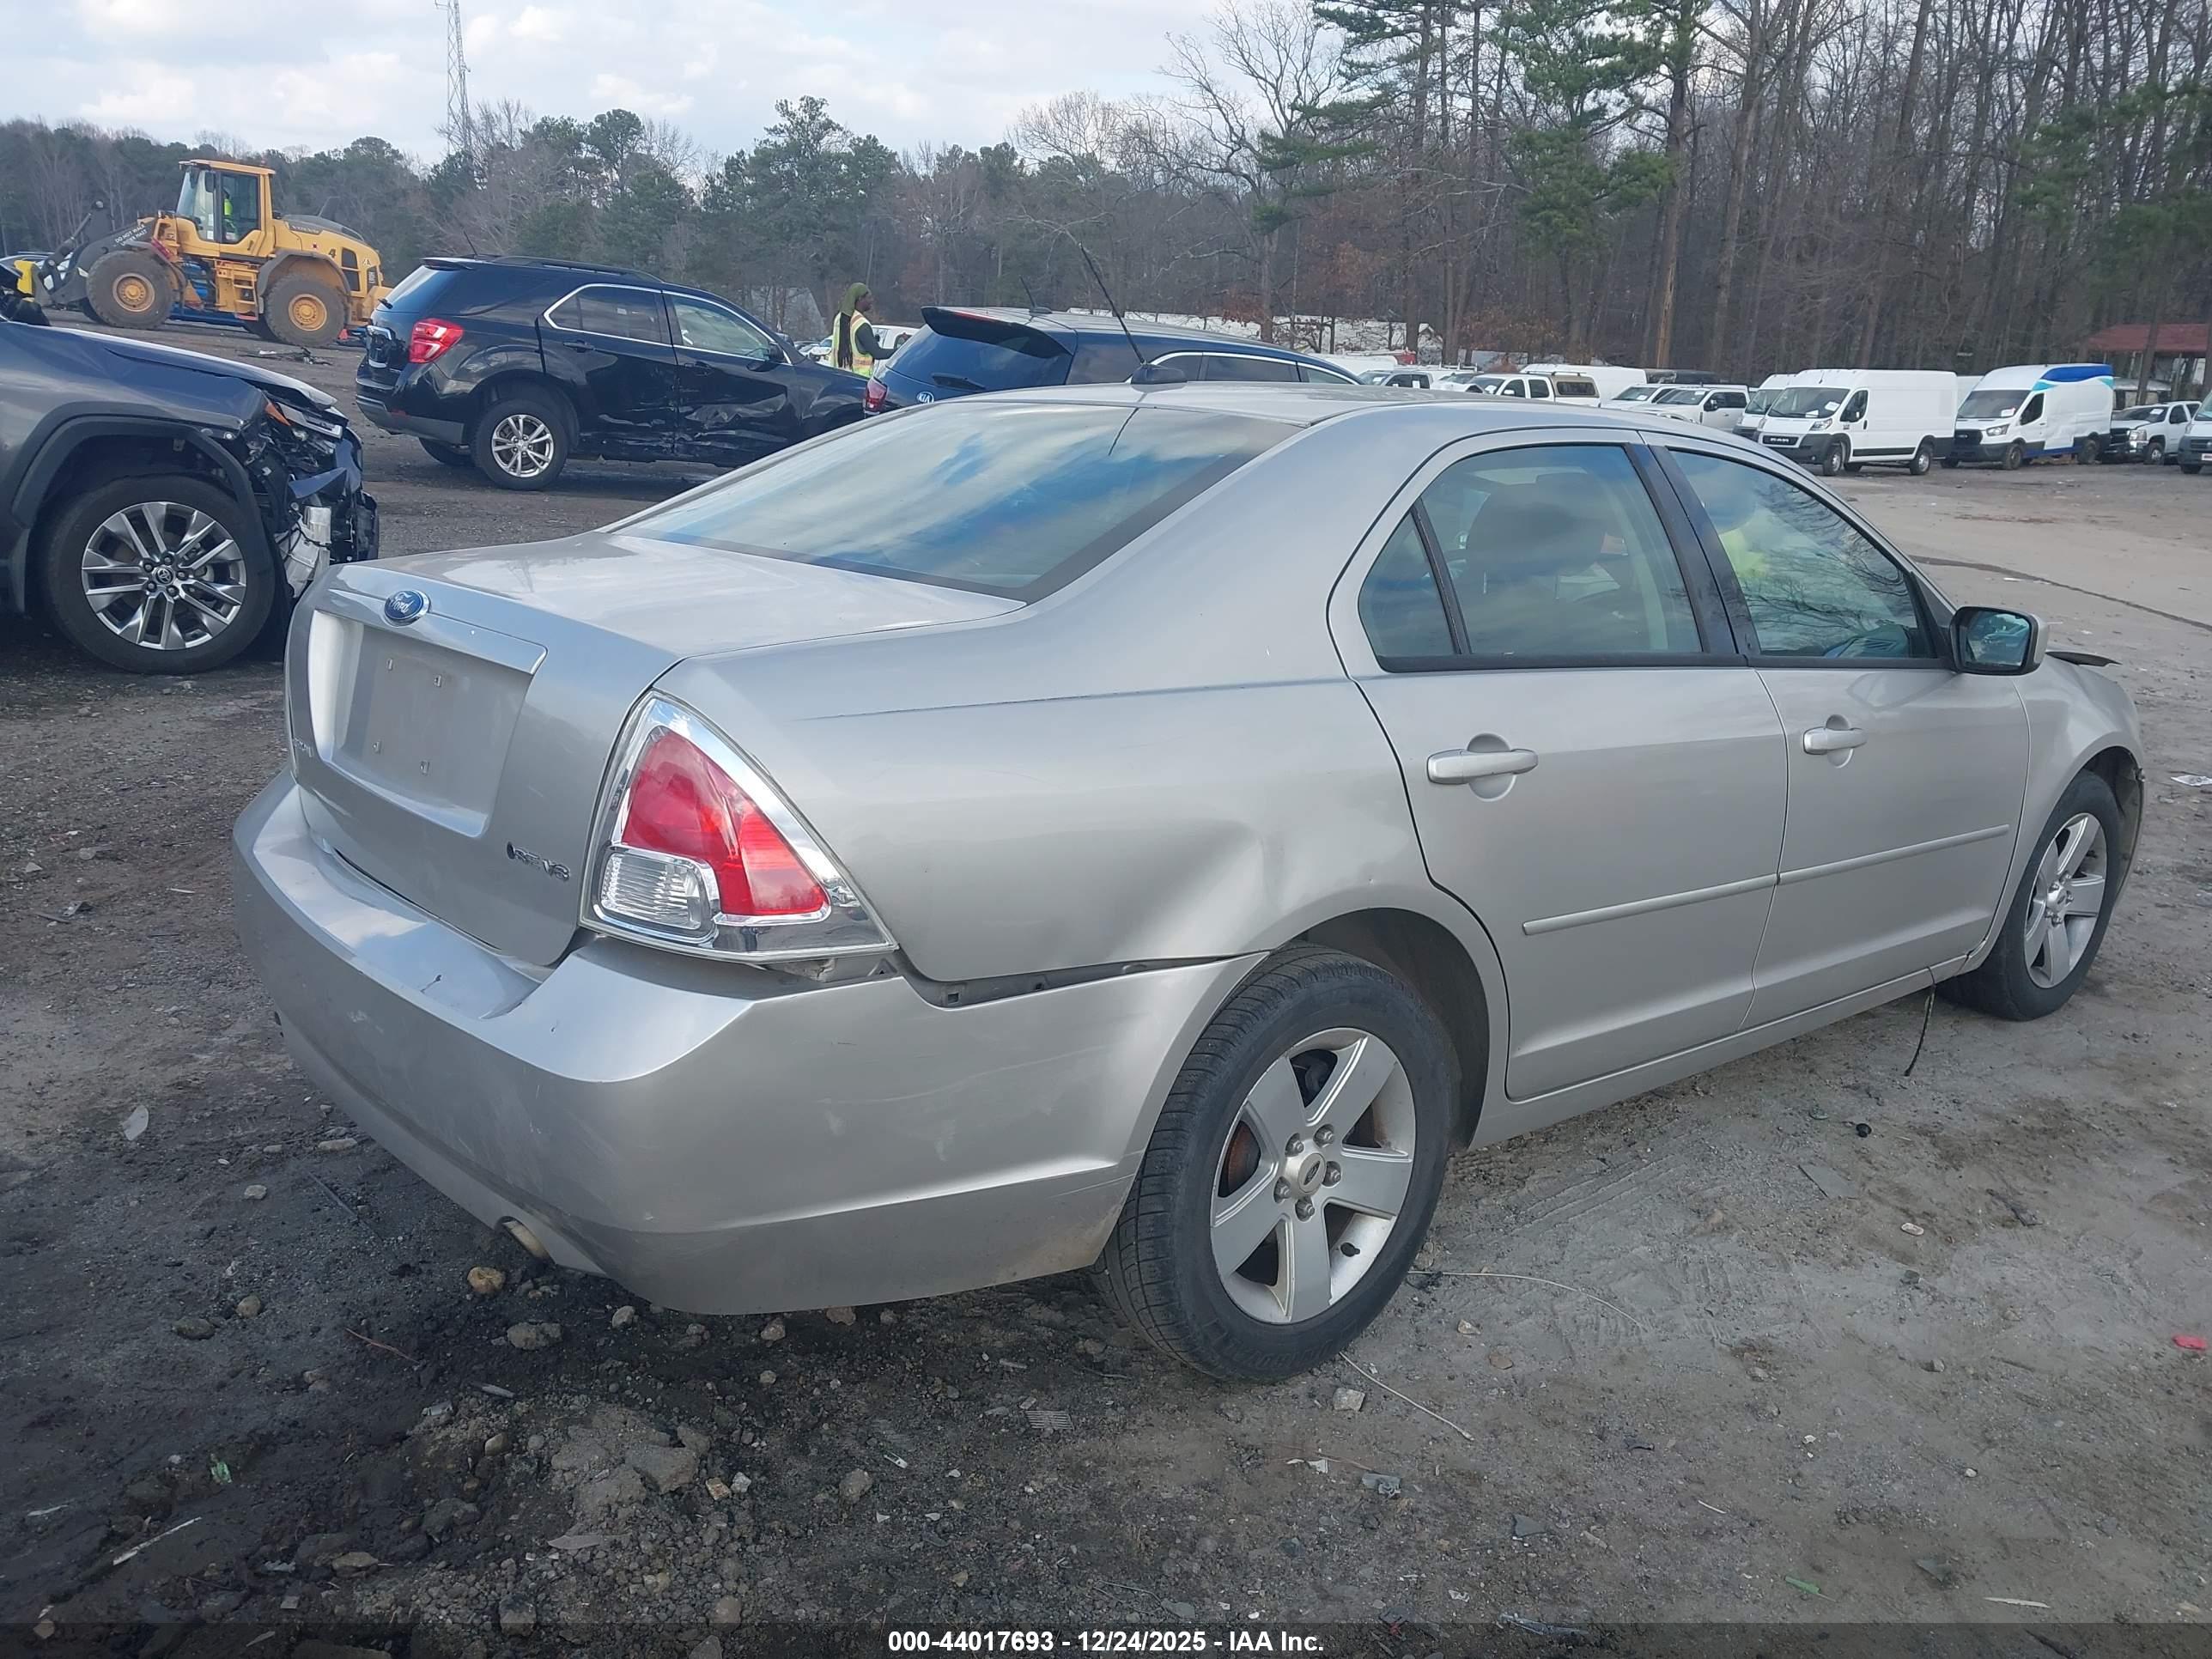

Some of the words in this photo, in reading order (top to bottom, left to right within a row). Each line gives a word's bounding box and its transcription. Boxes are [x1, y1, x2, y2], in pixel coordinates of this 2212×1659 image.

[122, 230, 132, 240] NOT
[131, 222, 145, 233] WALK
[328, 248, 337, 258] 4
[917, 393, 930, 404] KIA
[388, 592, 416, 614] Ford
